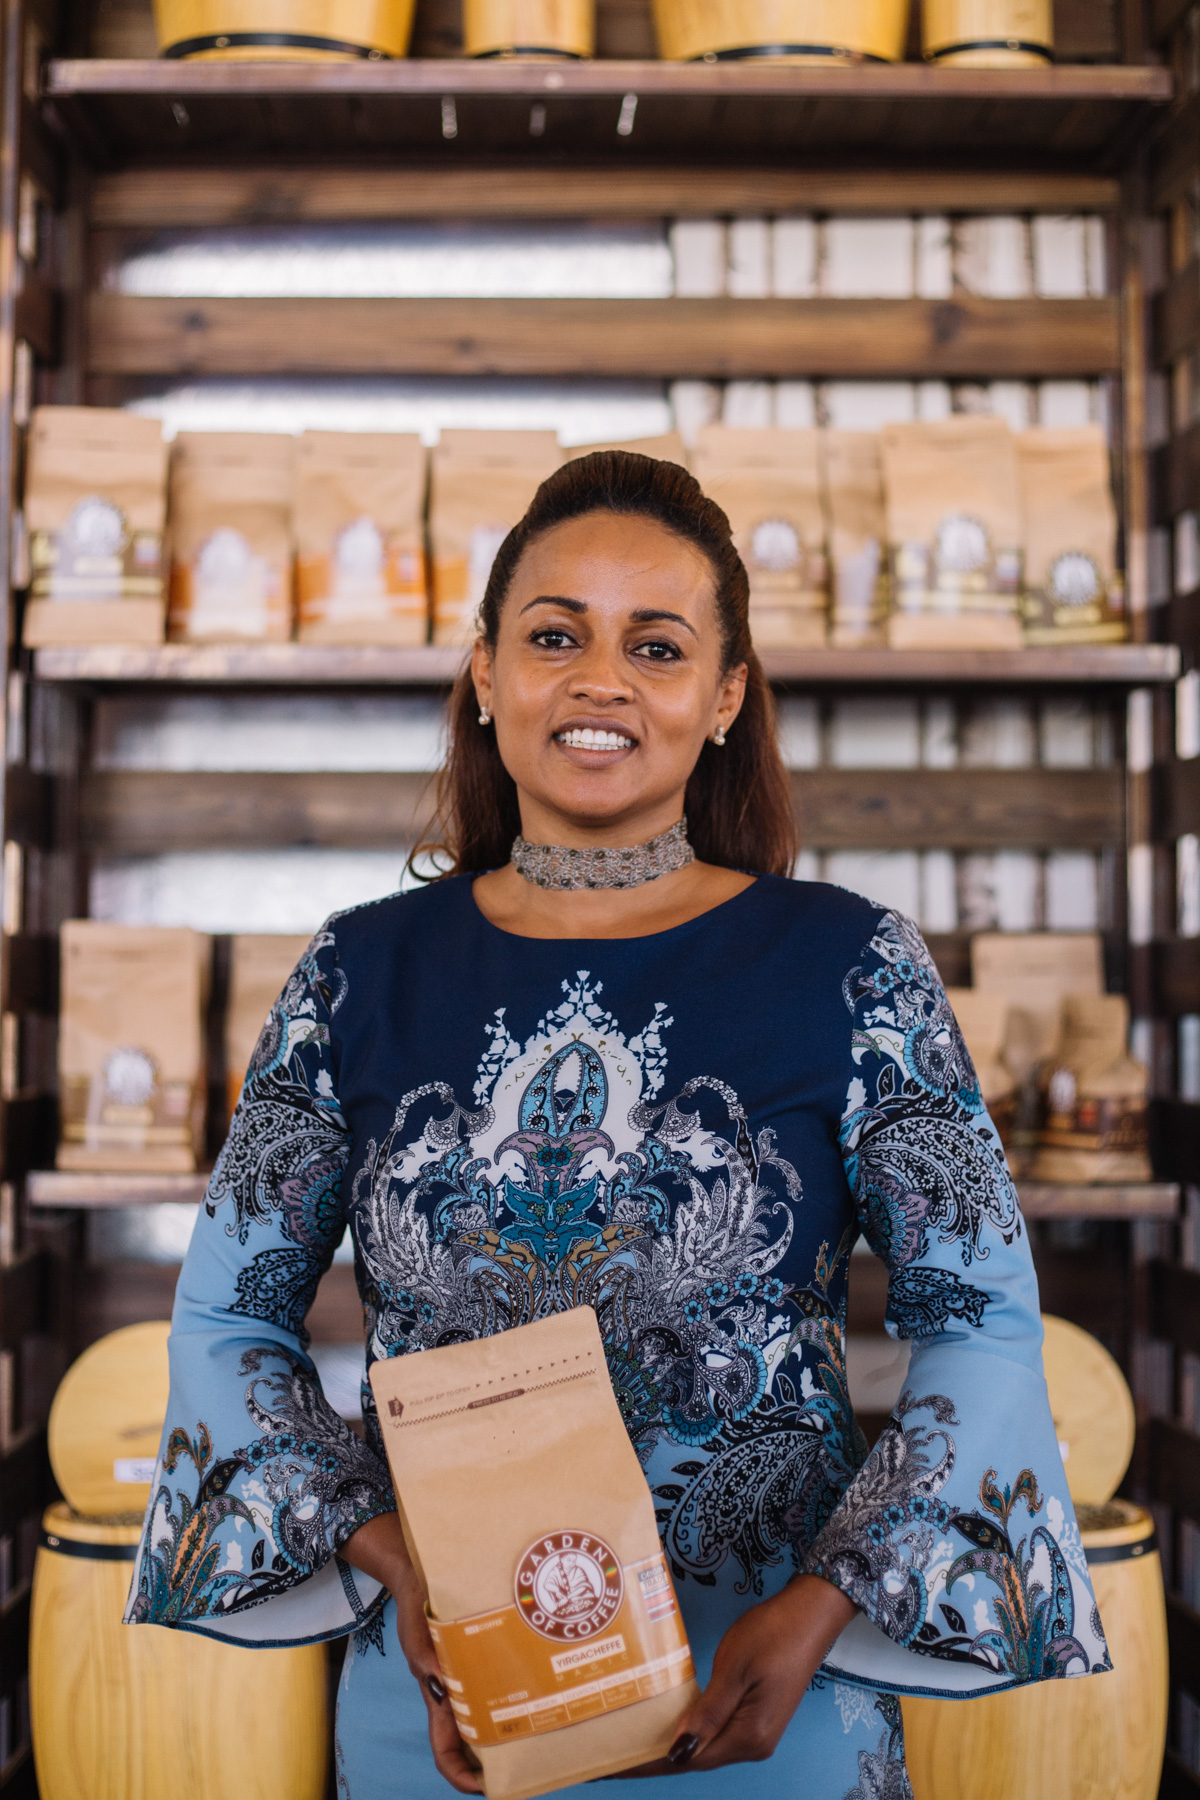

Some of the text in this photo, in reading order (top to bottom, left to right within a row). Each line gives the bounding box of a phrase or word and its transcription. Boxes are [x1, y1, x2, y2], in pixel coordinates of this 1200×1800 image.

[409, 1399, 422, 1407] PULL
[520, 1534, 619, 1638] GARDEN OF COFFEE
[556, 1640, 622, 1668] YIRGACHEFFE
